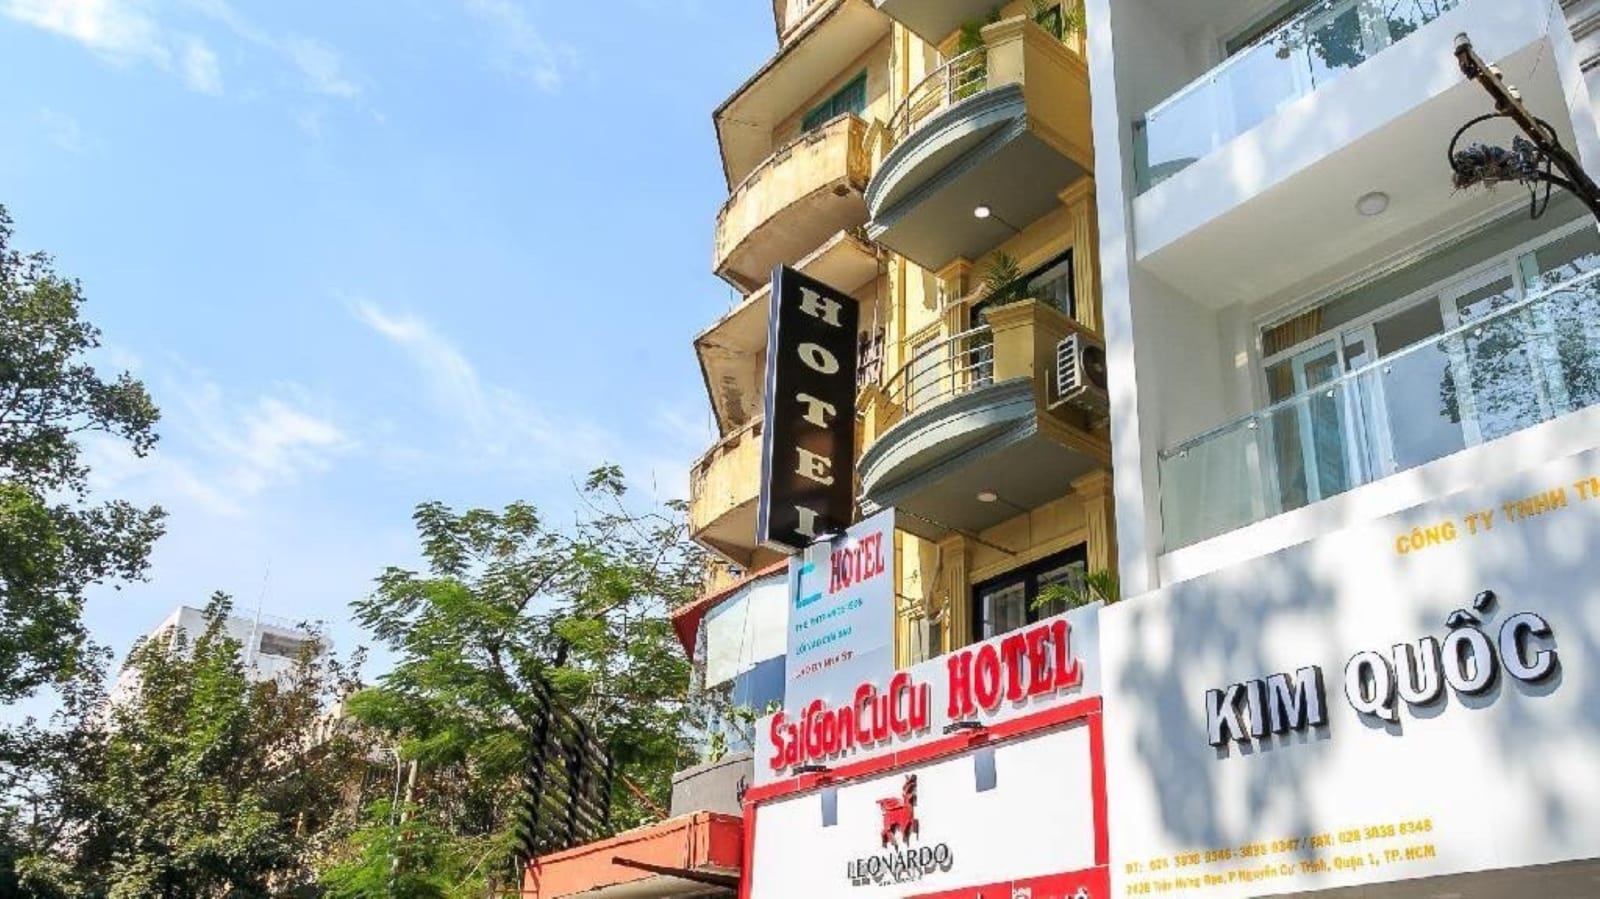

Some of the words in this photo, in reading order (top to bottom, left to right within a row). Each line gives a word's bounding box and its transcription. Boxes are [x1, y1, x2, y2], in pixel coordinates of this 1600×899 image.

[1395, 520, 1457, 554] CÔNG
[1464, 509, 1494, 535] TY
[1502, 487, 1568, 522] TNHH
[829, 530, 885, 594] HOTEL
[770, 673, 930, 769] SaiGonCuCu
[947, 620, 1082, 719] HOTEL
[1205, 665, 1329, 748] KIM
[1344, 590, 1557, 724] QUỐC
[847, 843, 952, 880] LEONARDO
